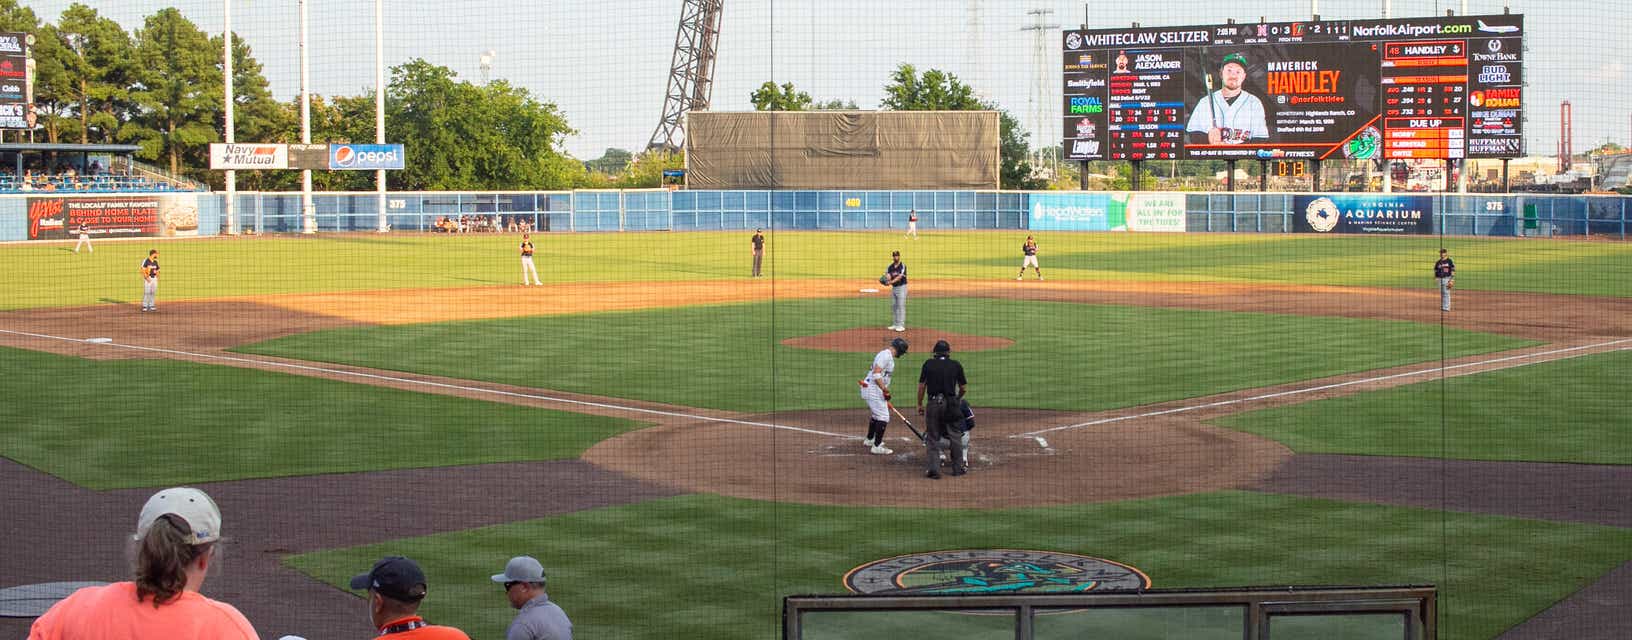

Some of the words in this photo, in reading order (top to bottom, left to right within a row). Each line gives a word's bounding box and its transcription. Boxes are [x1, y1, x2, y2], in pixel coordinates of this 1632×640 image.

[1284, 26, 1290, 34] 3
[1353, 24, 1472, 36] NorfolkAirport.com
[1085, 32, 1158, 46] WHITECLAW
[1160, 30, 1209, 43] SELTZER
[1405, 46, 1446, 55] HANDLEY
[1135, 61, 1181, 69] ALEXANDER
[1268, 61, 1318, 71] MAVERICK
[1483, 66, 1506, 74] BUD
[1267, 70, 1340, 94] HANDLEY
[1478, 73, 1510, 83] LIGHT
[1067, 79, 1105, 89] Smithfield
[1485, 89, 1520, 98] FAMILY
[1071, 97, 1102, 105] ROYAL
[1291, 96, 1344, 105] @norfolktides
[1485, 98, 1520, 107] DOLLAR
[1071, 105, 1103, 114] FARMS
[225, 145, 255, 155] Navy
[1072, 140, 1100, 154] Langley
[234, 155, 275, 164] Mutual
[357, 149, 397, 164] pepsi
[1279, 162, 1304, 176] 0:13
[1486, 202, 1503, 211] 375
[1345, 210, 1421, 219] AQUARIUM
